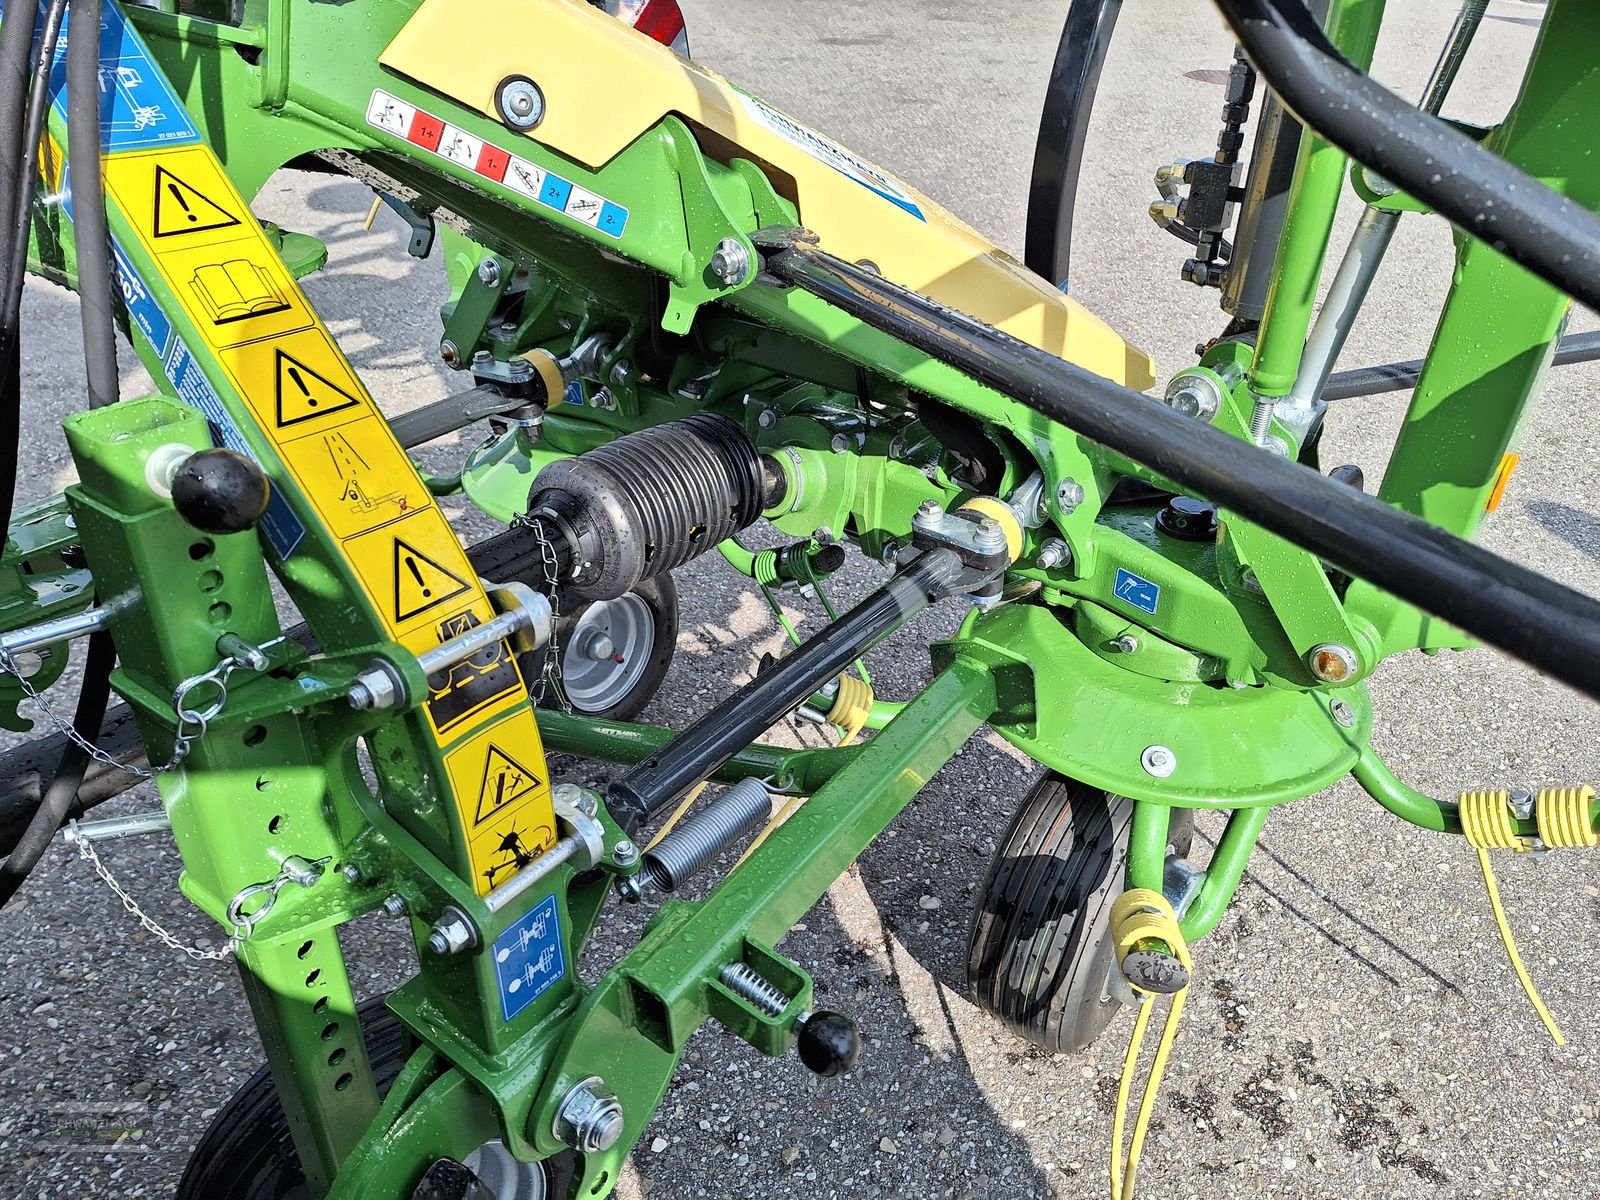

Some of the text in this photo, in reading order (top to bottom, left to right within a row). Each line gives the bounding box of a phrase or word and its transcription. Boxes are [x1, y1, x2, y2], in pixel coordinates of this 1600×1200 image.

[421, 127, 434, 138] 1+
[488, 159, 497, 168] 1-
[548, 187, 560, 198] 2+
[606, 215, 615, 224] 2-
